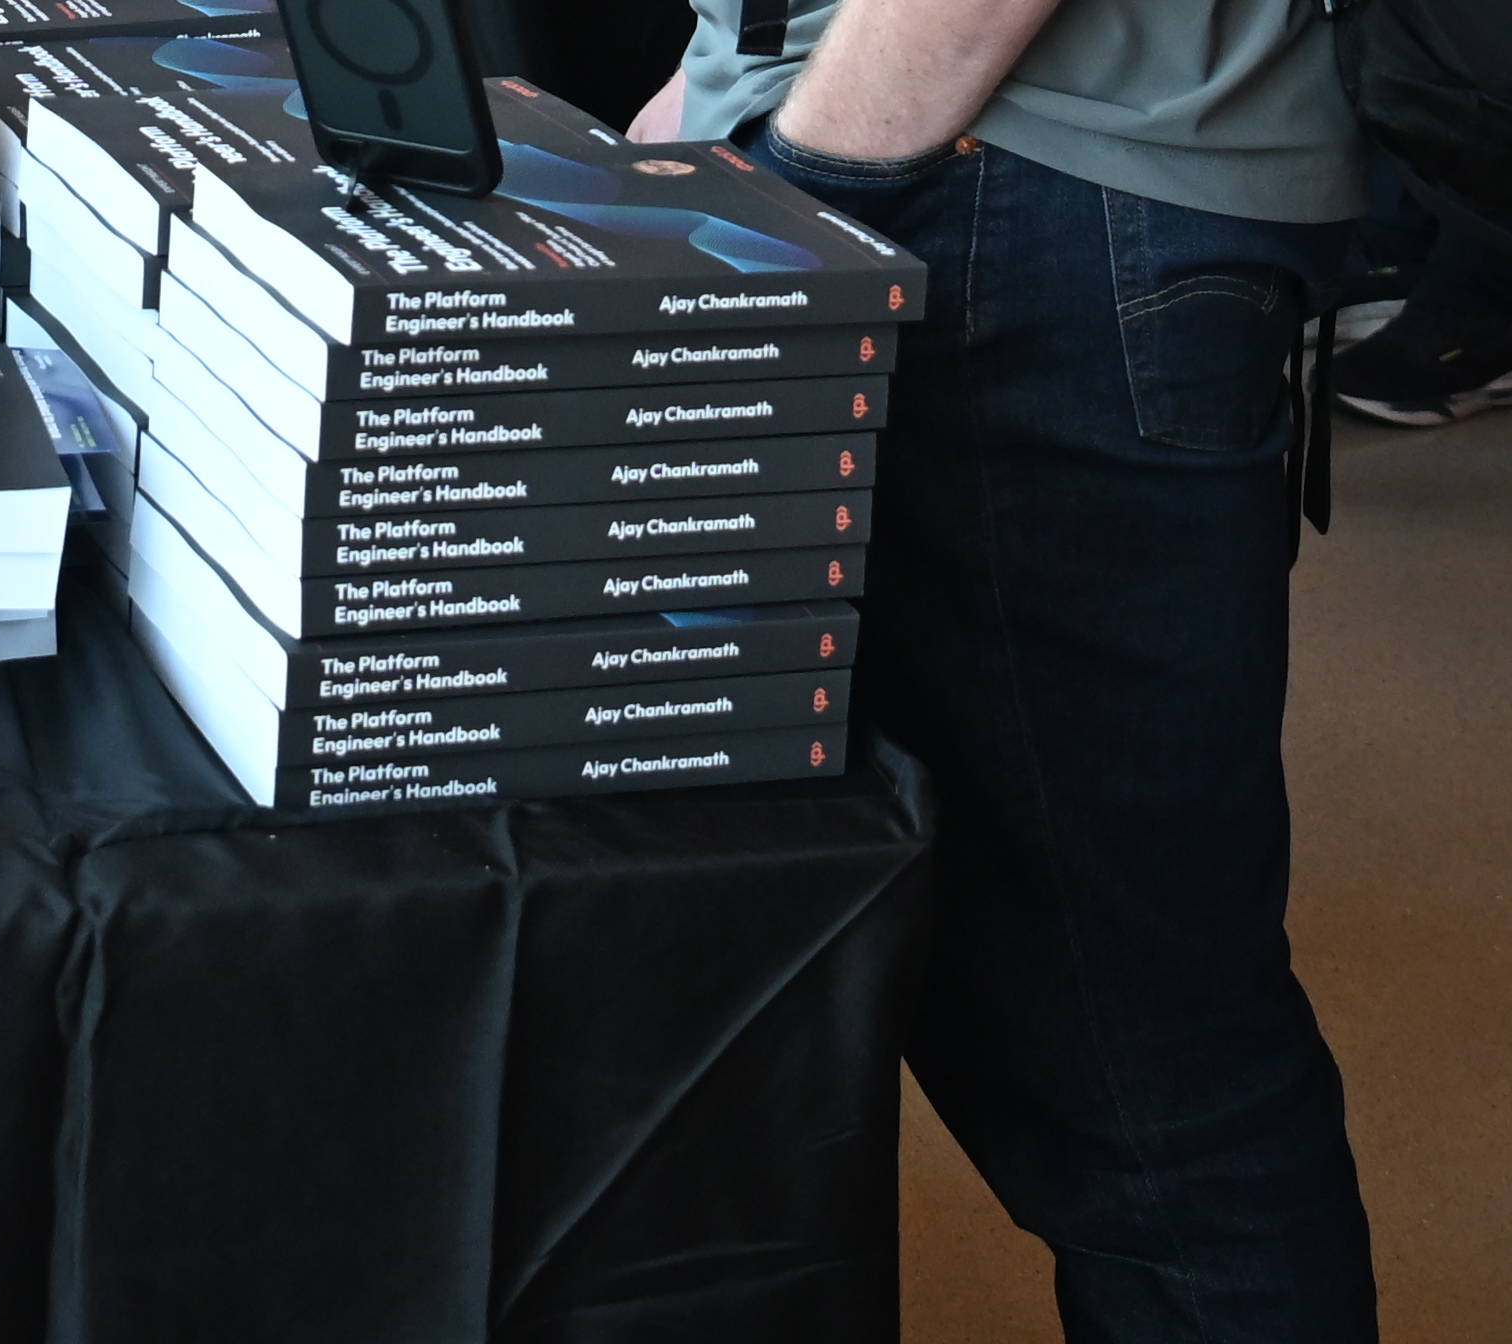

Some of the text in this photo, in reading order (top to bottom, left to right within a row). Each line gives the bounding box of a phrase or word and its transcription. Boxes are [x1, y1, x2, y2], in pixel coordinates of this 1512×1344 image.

[387, 290, 506, 309] The Platform
[659, 291, 808, 314] Ajay Chankramath
[386, 309, 574, 335] Engineer's Handbook
[362, 346, 479, 366] The Platform
[632, 344, 779, 368] Ajay Chankramath
[360, 363, 548, 392] Engineer's Handbook
[356, 407, 474, 427] The Platform
[626, 401, 772, 427] Ajay Chankramath
[355, 423, 542, 452] Engineer's Handbook
[340, 464, 459, 484] The Platform
[611, 458, 759, 484] Ajay Chankramath
[339, 480, 527, 509] Engineer's Handbook
[337, 519, 455, 540] The Platform
[608, 514, 755, 540] Ajay Chankramath
[337, 536, 524, 566] Engineer's Handbook
[335, 579, 452, 600] The Platform
[603, 569, 749, 597] Ajay Chankramath
[335, 594, 520, 626] Engineer's Handbook
[321, 653, 439, 674] The Platform
[592, 642, 739, 669] Ajay Chankramath
[320, 668, 507, 699] Engineer's Handbook
[314, 710, 432, 731] The Platform
[585, 697, 732, 725] Ajay Chankramath
[313, 724, 500, 756] Engineer's Handbook
[311, 763, 429, 784] The Platform
[582, 751, 729, 778] Ajay Chankramath
[406, 777, 496, 798] Handbook
